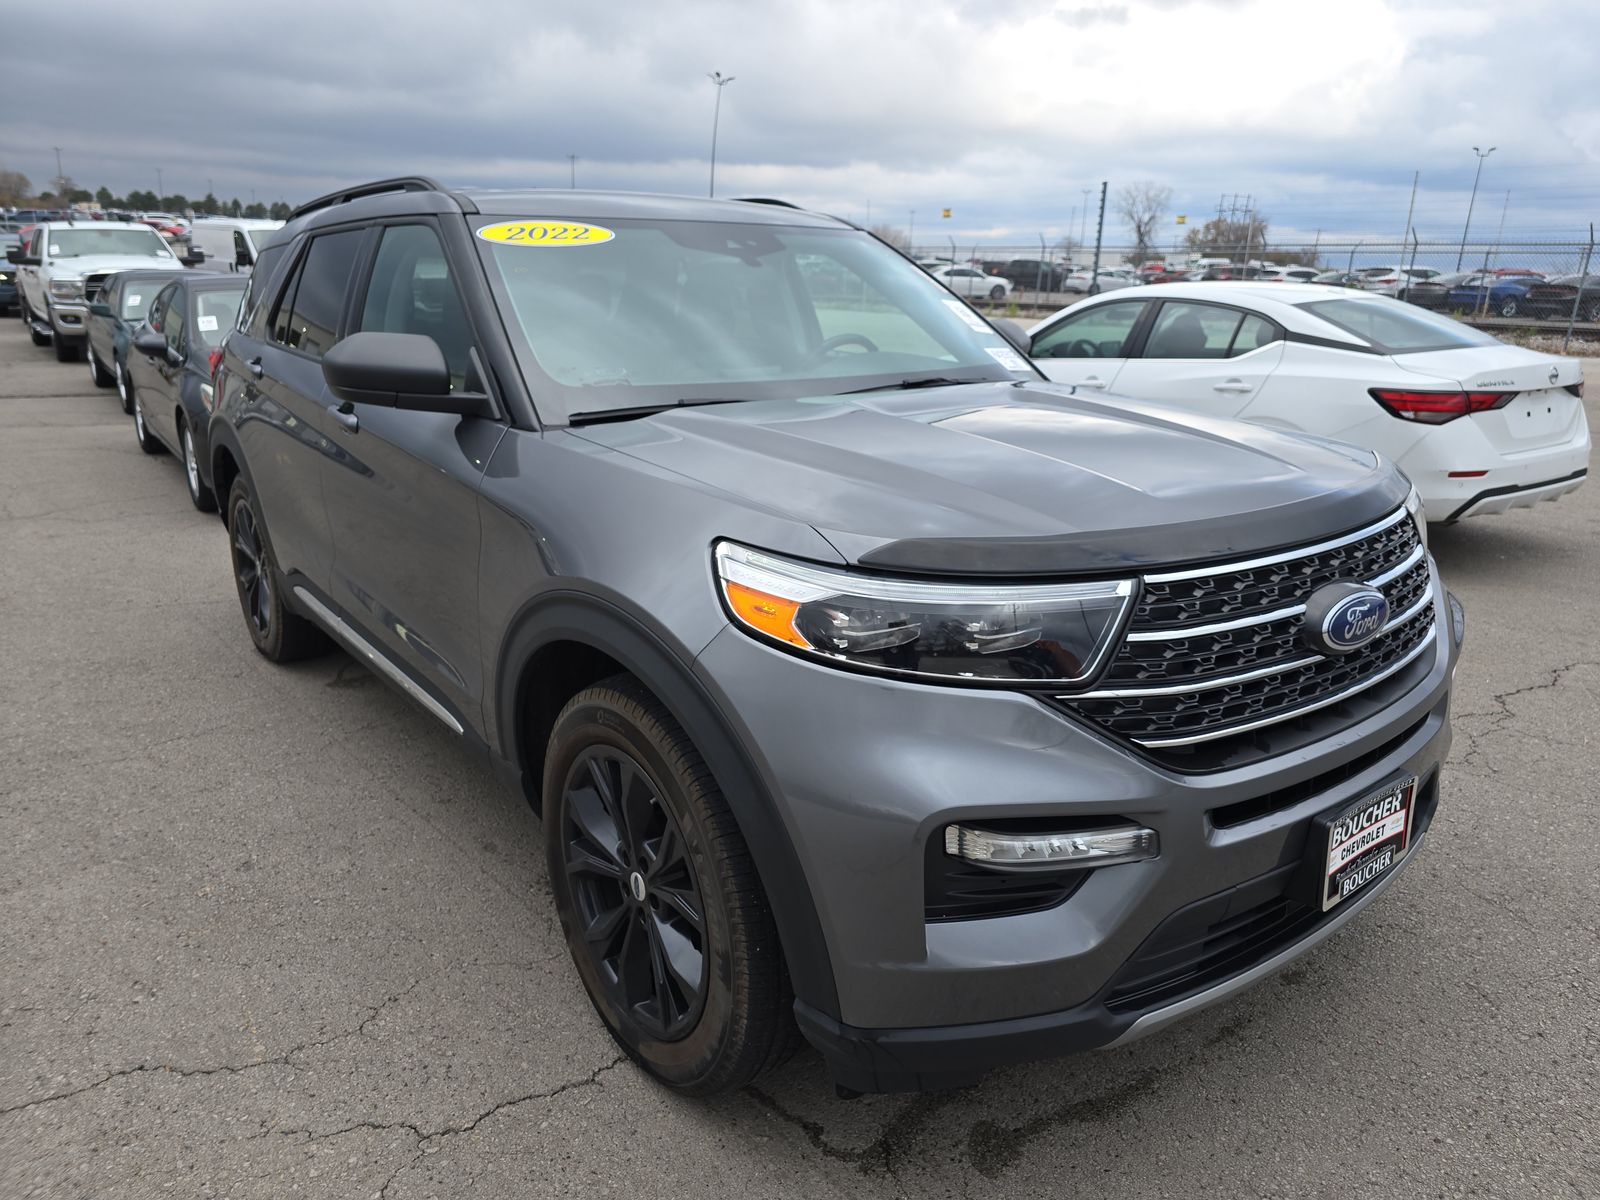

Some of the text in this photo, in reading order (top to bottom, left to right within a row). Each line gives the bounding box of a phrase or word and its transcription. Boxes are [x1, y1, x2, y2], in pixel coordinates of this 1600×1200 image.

[506, 226, 590, 241] 2022
[1344, 603, 1380, 640] Ford
[1332, 793, 1402, 848] BOUCHER
[1340, 824, 1387, 861] CHEVROLET
[1342, 852, 1392, 896] BOUCHER
